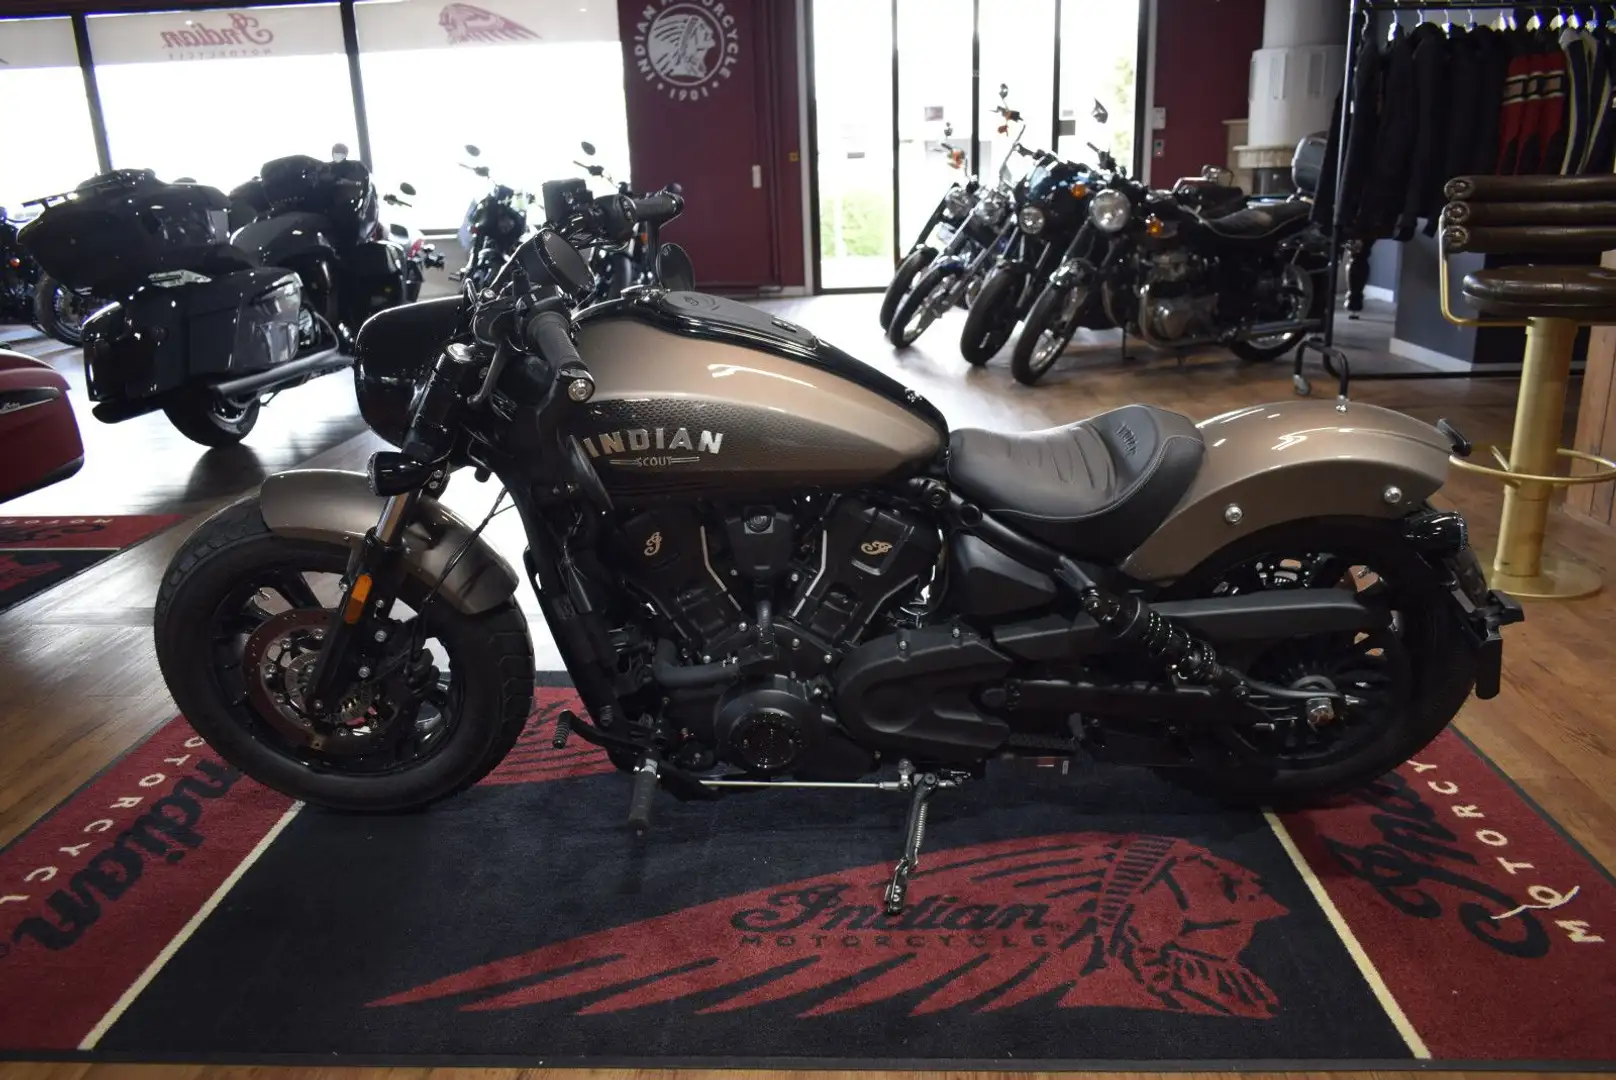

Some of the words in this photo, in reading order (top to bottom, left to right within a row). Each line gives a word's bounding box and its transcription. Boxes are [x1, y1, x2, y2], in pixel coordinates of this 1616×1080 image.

[633, 4, 658, 82] INDIAN
[669, 86, 708, 101] 1901
[583, 427, 723, 458] INDIAN
[635, 456, 673, 467] SCOUT
[0, 736, 206, 904] OTORCYCL
[13, 757, 242, 950] ndian
[1407, 759, 1605, 942] MOTORCY
[731, 883, 1049, 932] Indian
[741, 934, 1047, 948] MOTORCYCLE
